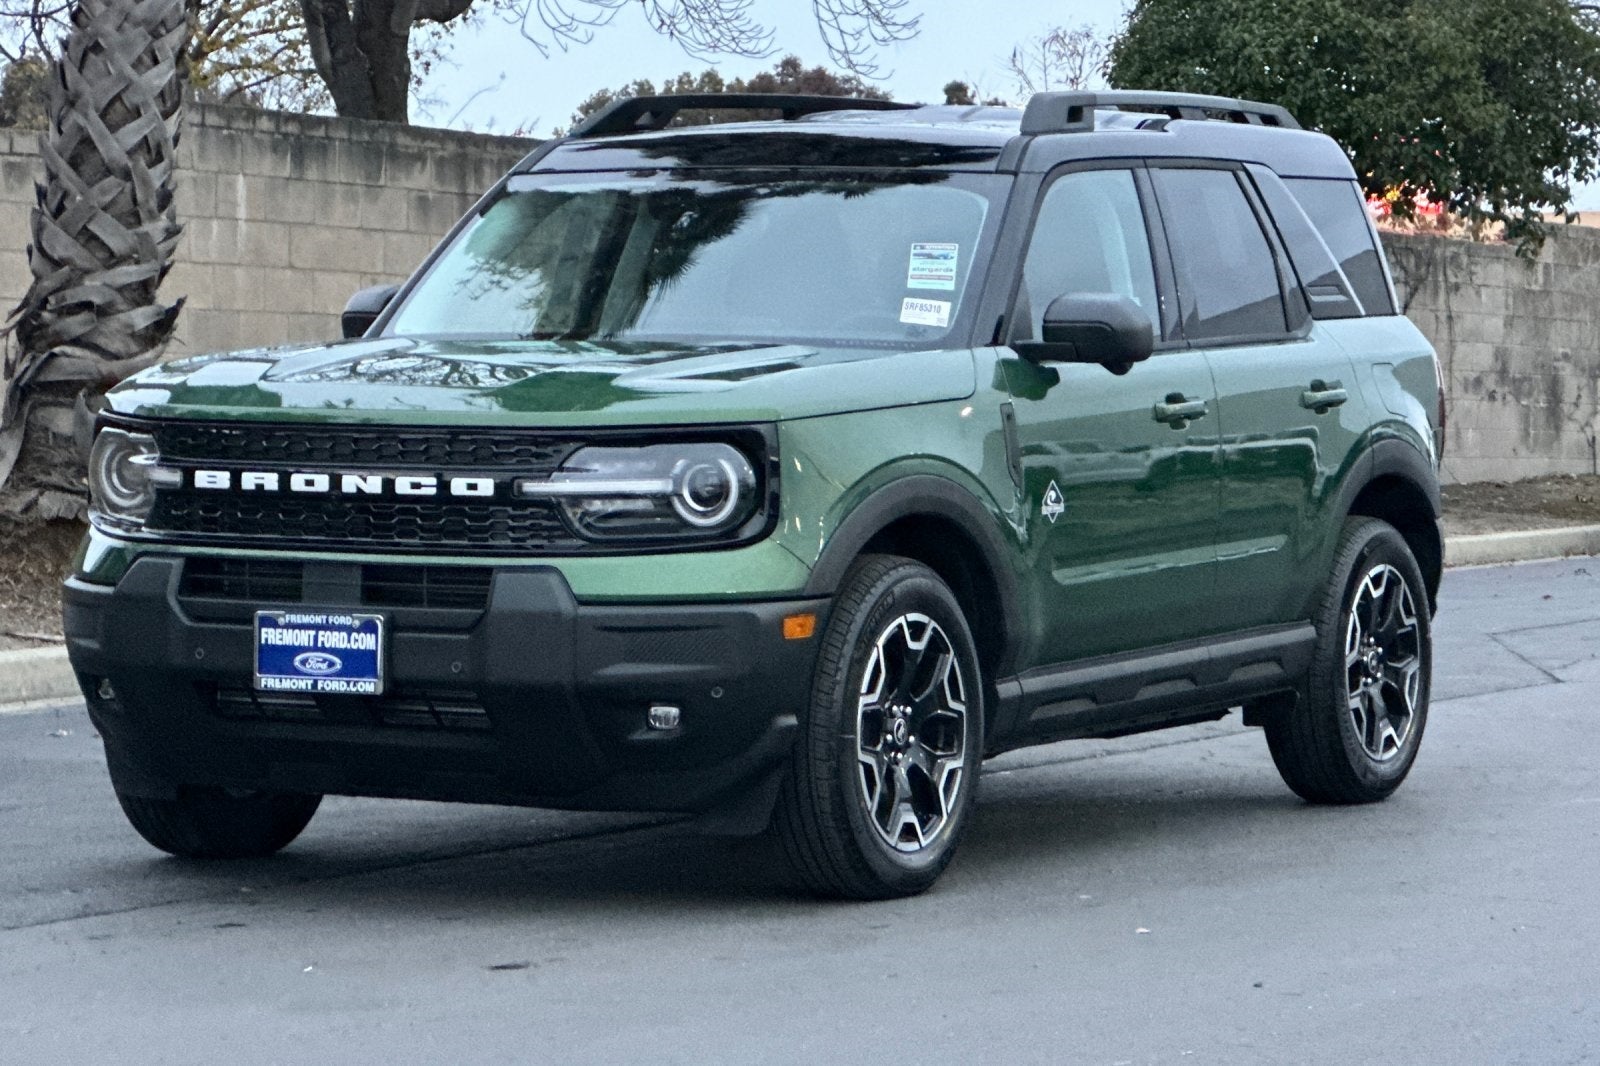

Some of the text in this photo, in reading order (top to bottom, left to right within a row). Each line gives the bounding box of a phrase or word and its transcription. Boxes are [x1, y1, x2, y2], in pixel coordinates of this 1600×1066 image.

[194, 470, 495, 496] BRONCO
[285, 614, 352, 625] FREMONT FORD
[261, 628, 376, 650] FREMONT FORD.COM
[305, 656, 329, 669] Ford
[261, 678, 375, 692] FREMONT FORD.COM
